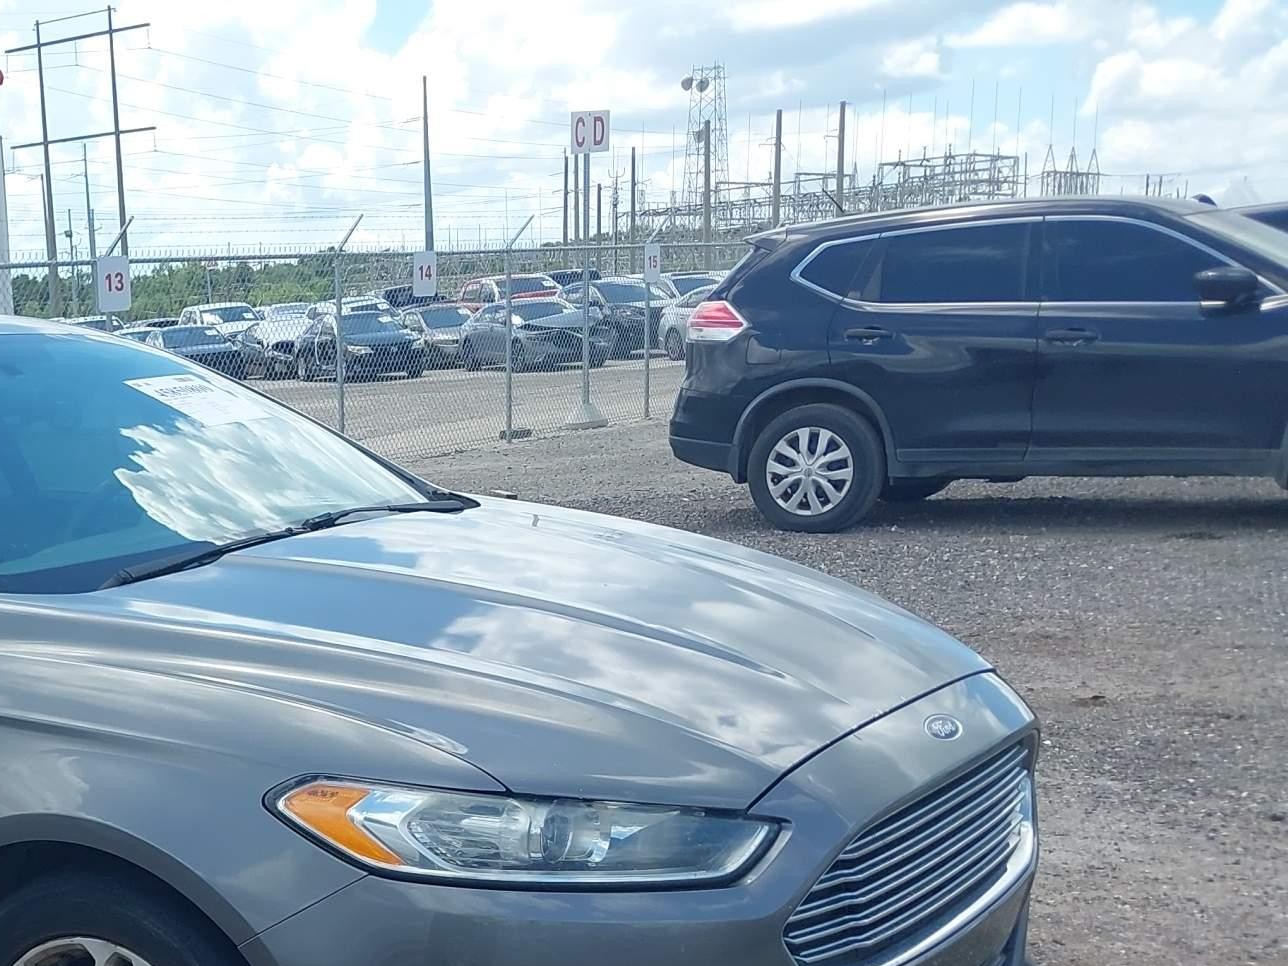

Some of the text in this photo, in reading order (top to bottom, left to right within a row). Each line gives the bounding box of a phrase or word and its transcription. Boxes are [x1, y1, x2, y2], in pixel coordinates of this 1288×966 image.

[575, 115, 605, 148] C D
[648, 255, 658, 269] 15
[418, 264, 432, 281] 14
[105, 272, 124, 292] 13
